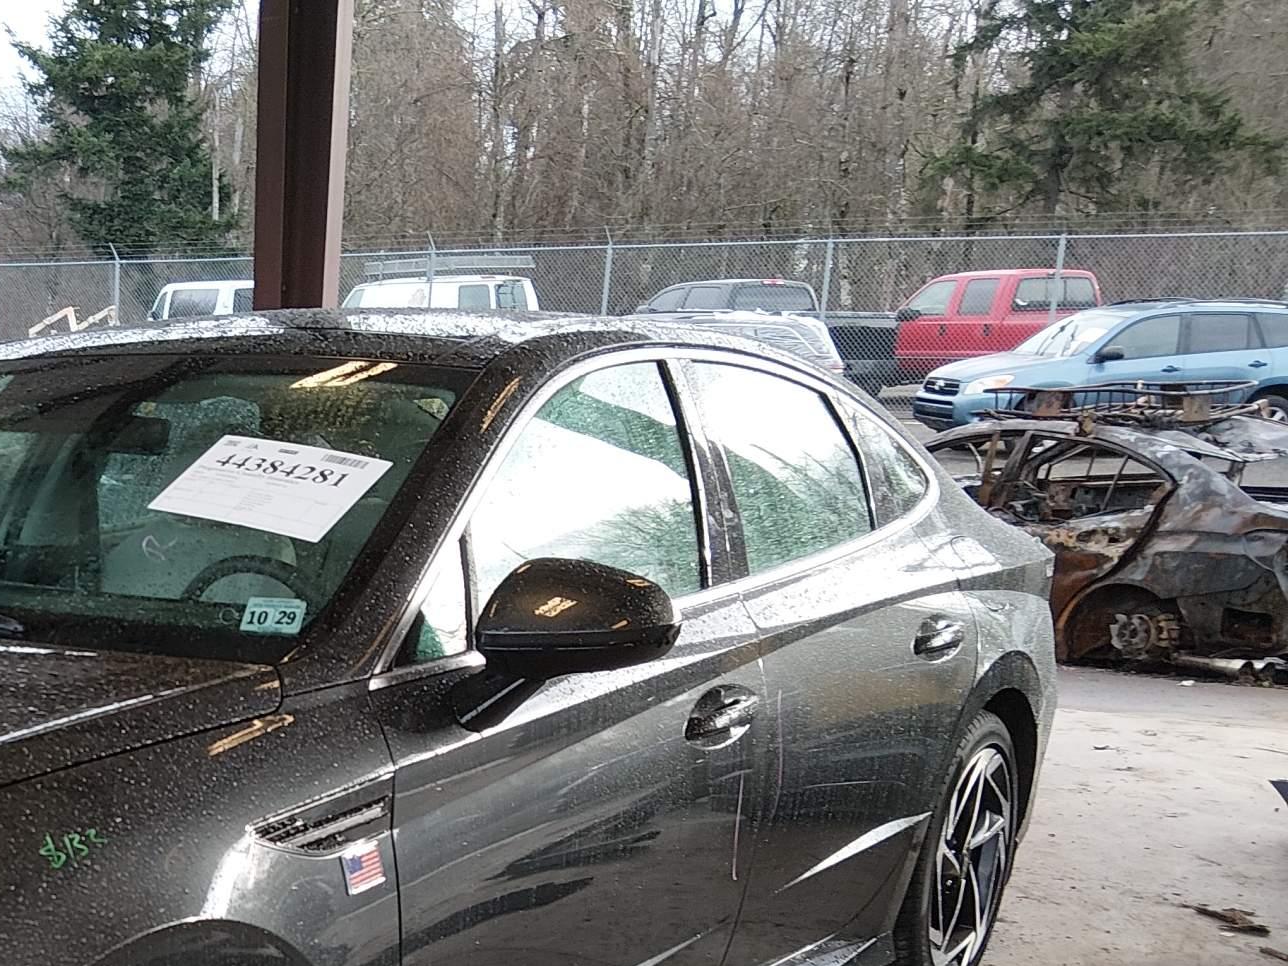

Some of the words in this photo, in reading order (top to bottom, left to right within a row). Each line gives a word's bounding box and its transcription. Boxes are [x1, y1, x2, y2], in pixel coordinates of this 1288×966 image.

[215, 453, 350, 488] 44384281
[247, 610, 269, 625] 10
[274, 610, 297, 625] 29
